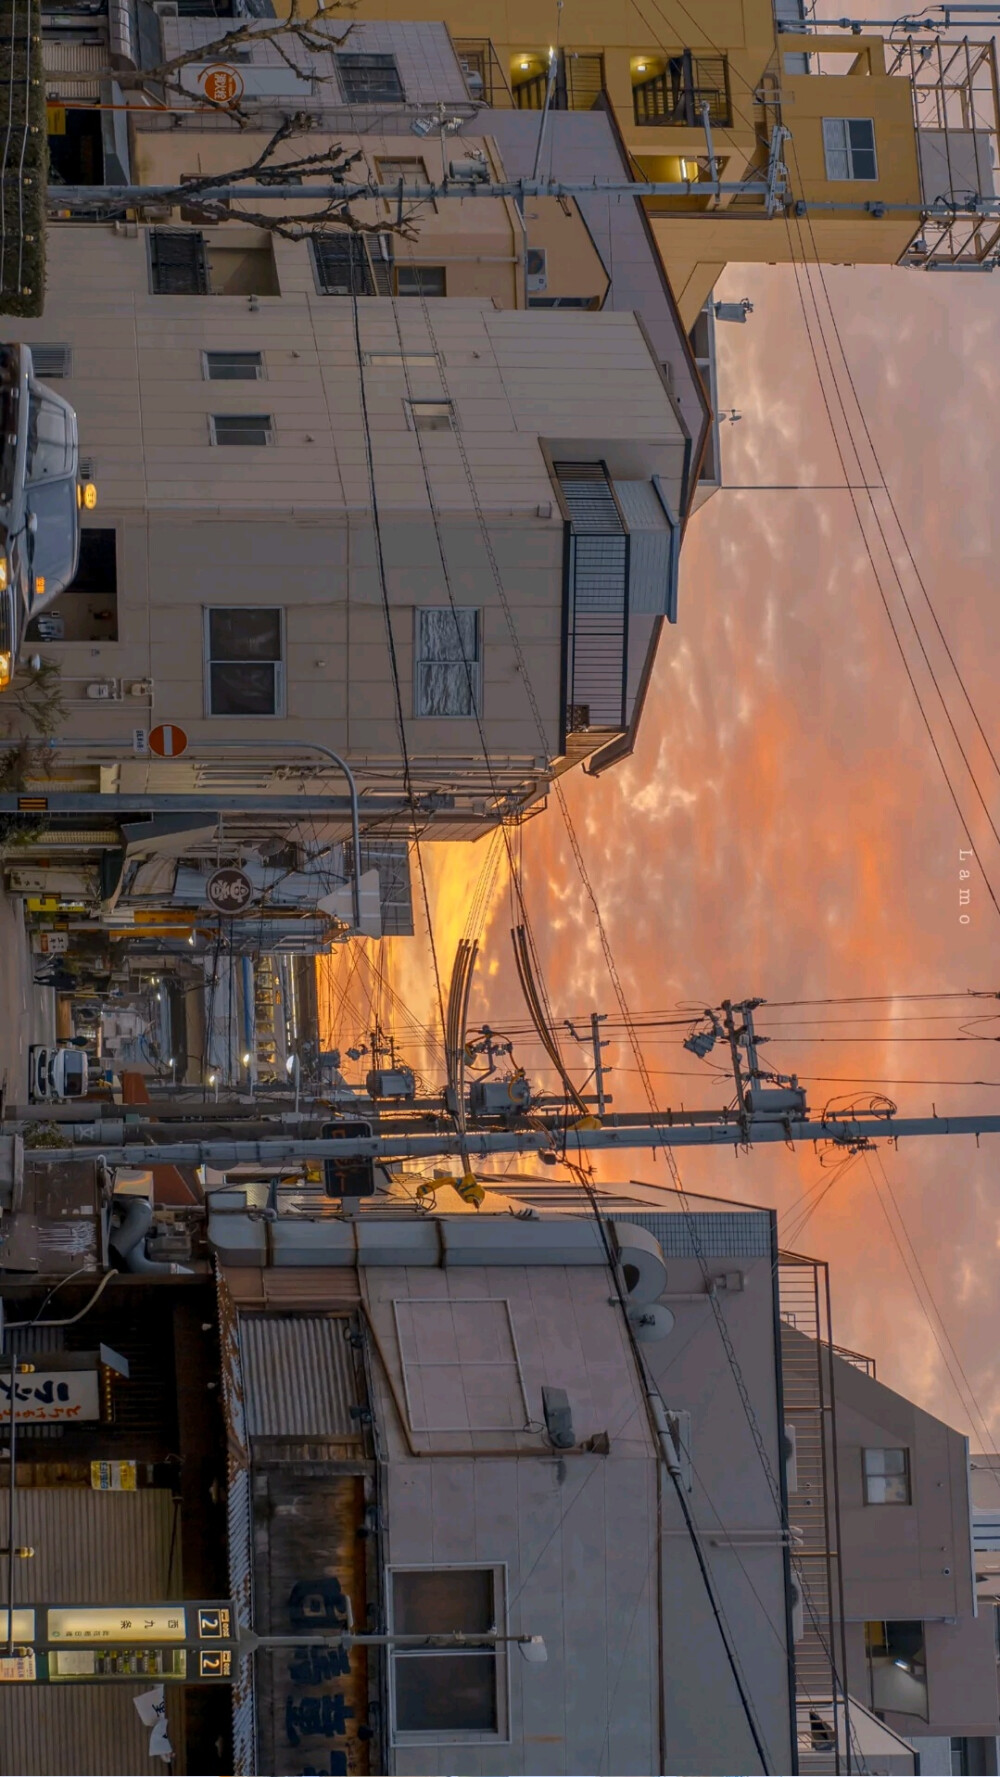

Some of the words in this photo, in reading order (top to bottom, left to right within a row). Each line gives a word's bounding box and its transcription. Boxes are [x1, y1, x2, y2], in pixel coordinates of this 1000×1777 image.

[80, 1126, 95, 1140] 文
[120, 1620, 178, 1630] 西九条
[202, 1618, 218, 1628] 2
[203, 1658, 220, 1668] 2
